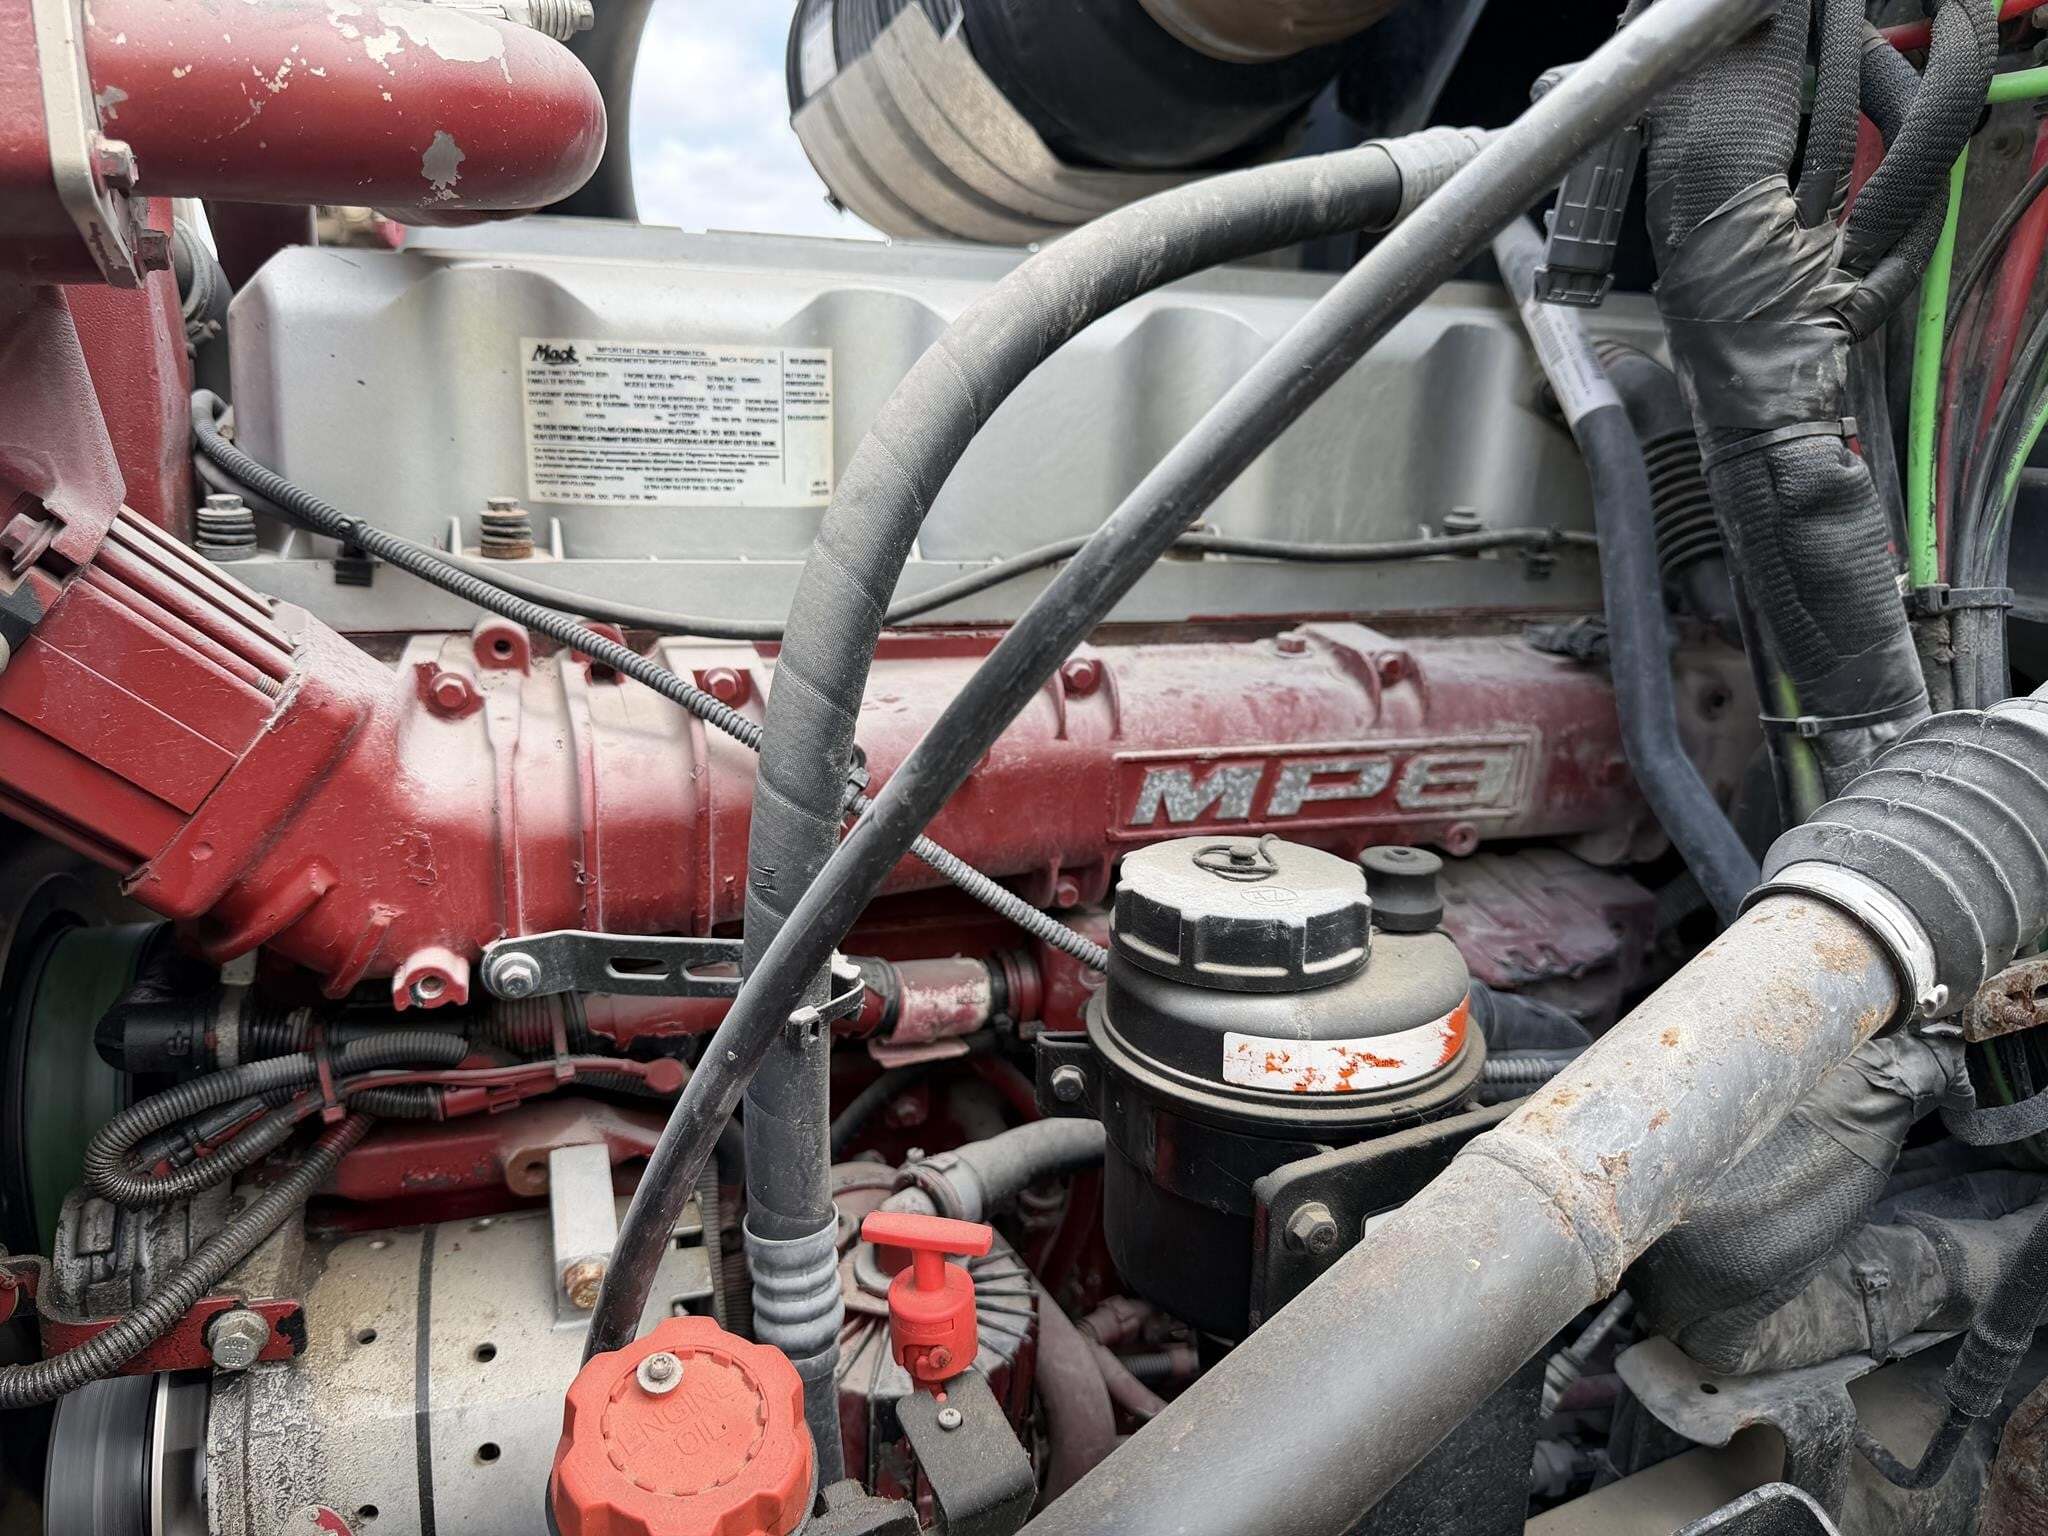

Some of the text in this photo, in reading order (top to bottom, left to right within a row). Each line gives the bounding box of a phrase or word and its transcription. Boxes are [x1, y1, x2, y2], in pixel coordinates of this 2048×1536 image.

[1130, 753, 1514, 825] MP8
[616, 1378, 739, 1456] ENGINE
[675, 1421, 728, 1455] OIL
